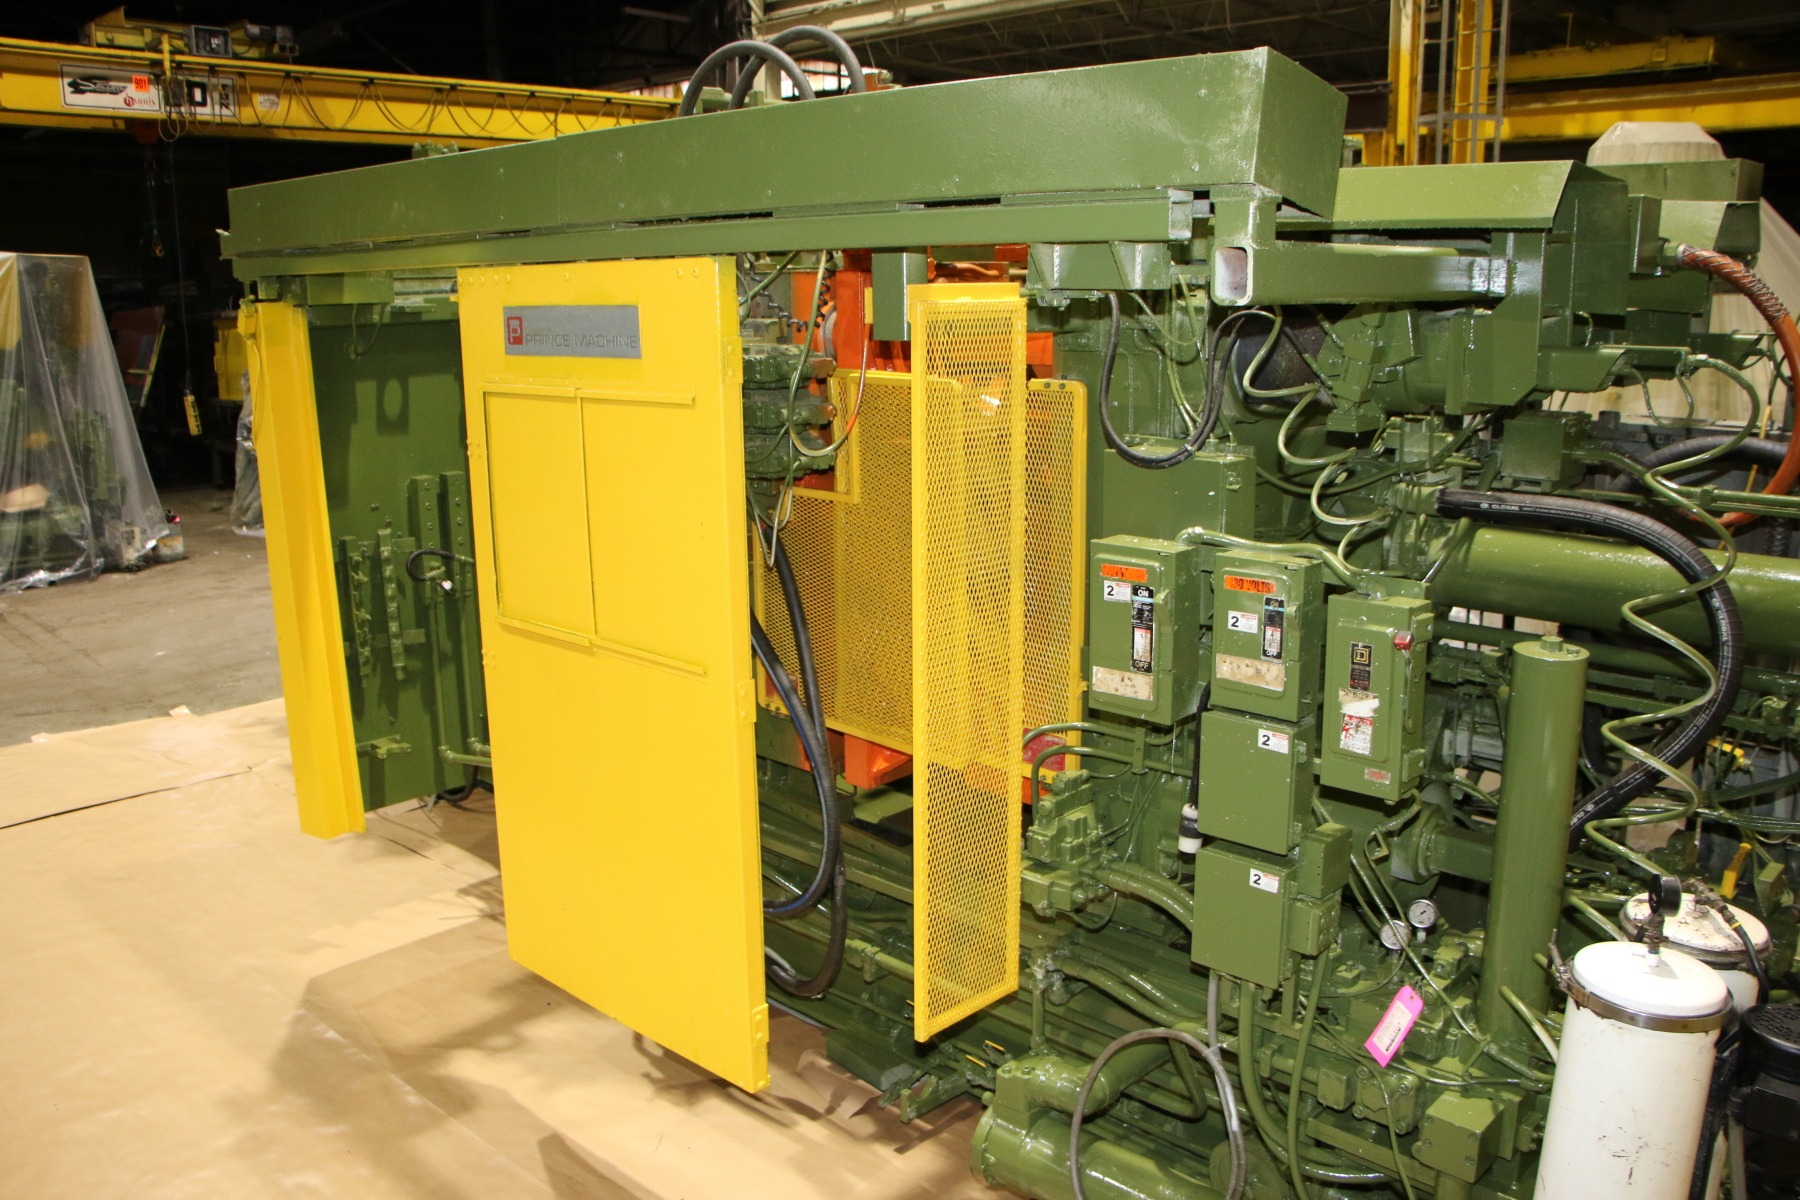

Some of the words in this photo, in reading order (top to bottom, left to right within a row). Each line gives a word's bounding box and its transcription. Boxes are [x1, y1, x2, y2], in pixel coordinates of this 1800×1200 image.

[134, 78, 147, 90] 901
[525, 334, 570, 347] PRINCE
[574, 334, 638, 349] MACHINE
[1106, 584, 1115, 597] 2
[1137, 588, 1149, 599] ON
[1230, 615, 1240, 628] 2
[1266, 649, 1278, 658] OFF
[1134, 660, 1149, 670] OFF
[1261, 733, 1271, 747] 2
[1252, 873, 1262, 886] 2
